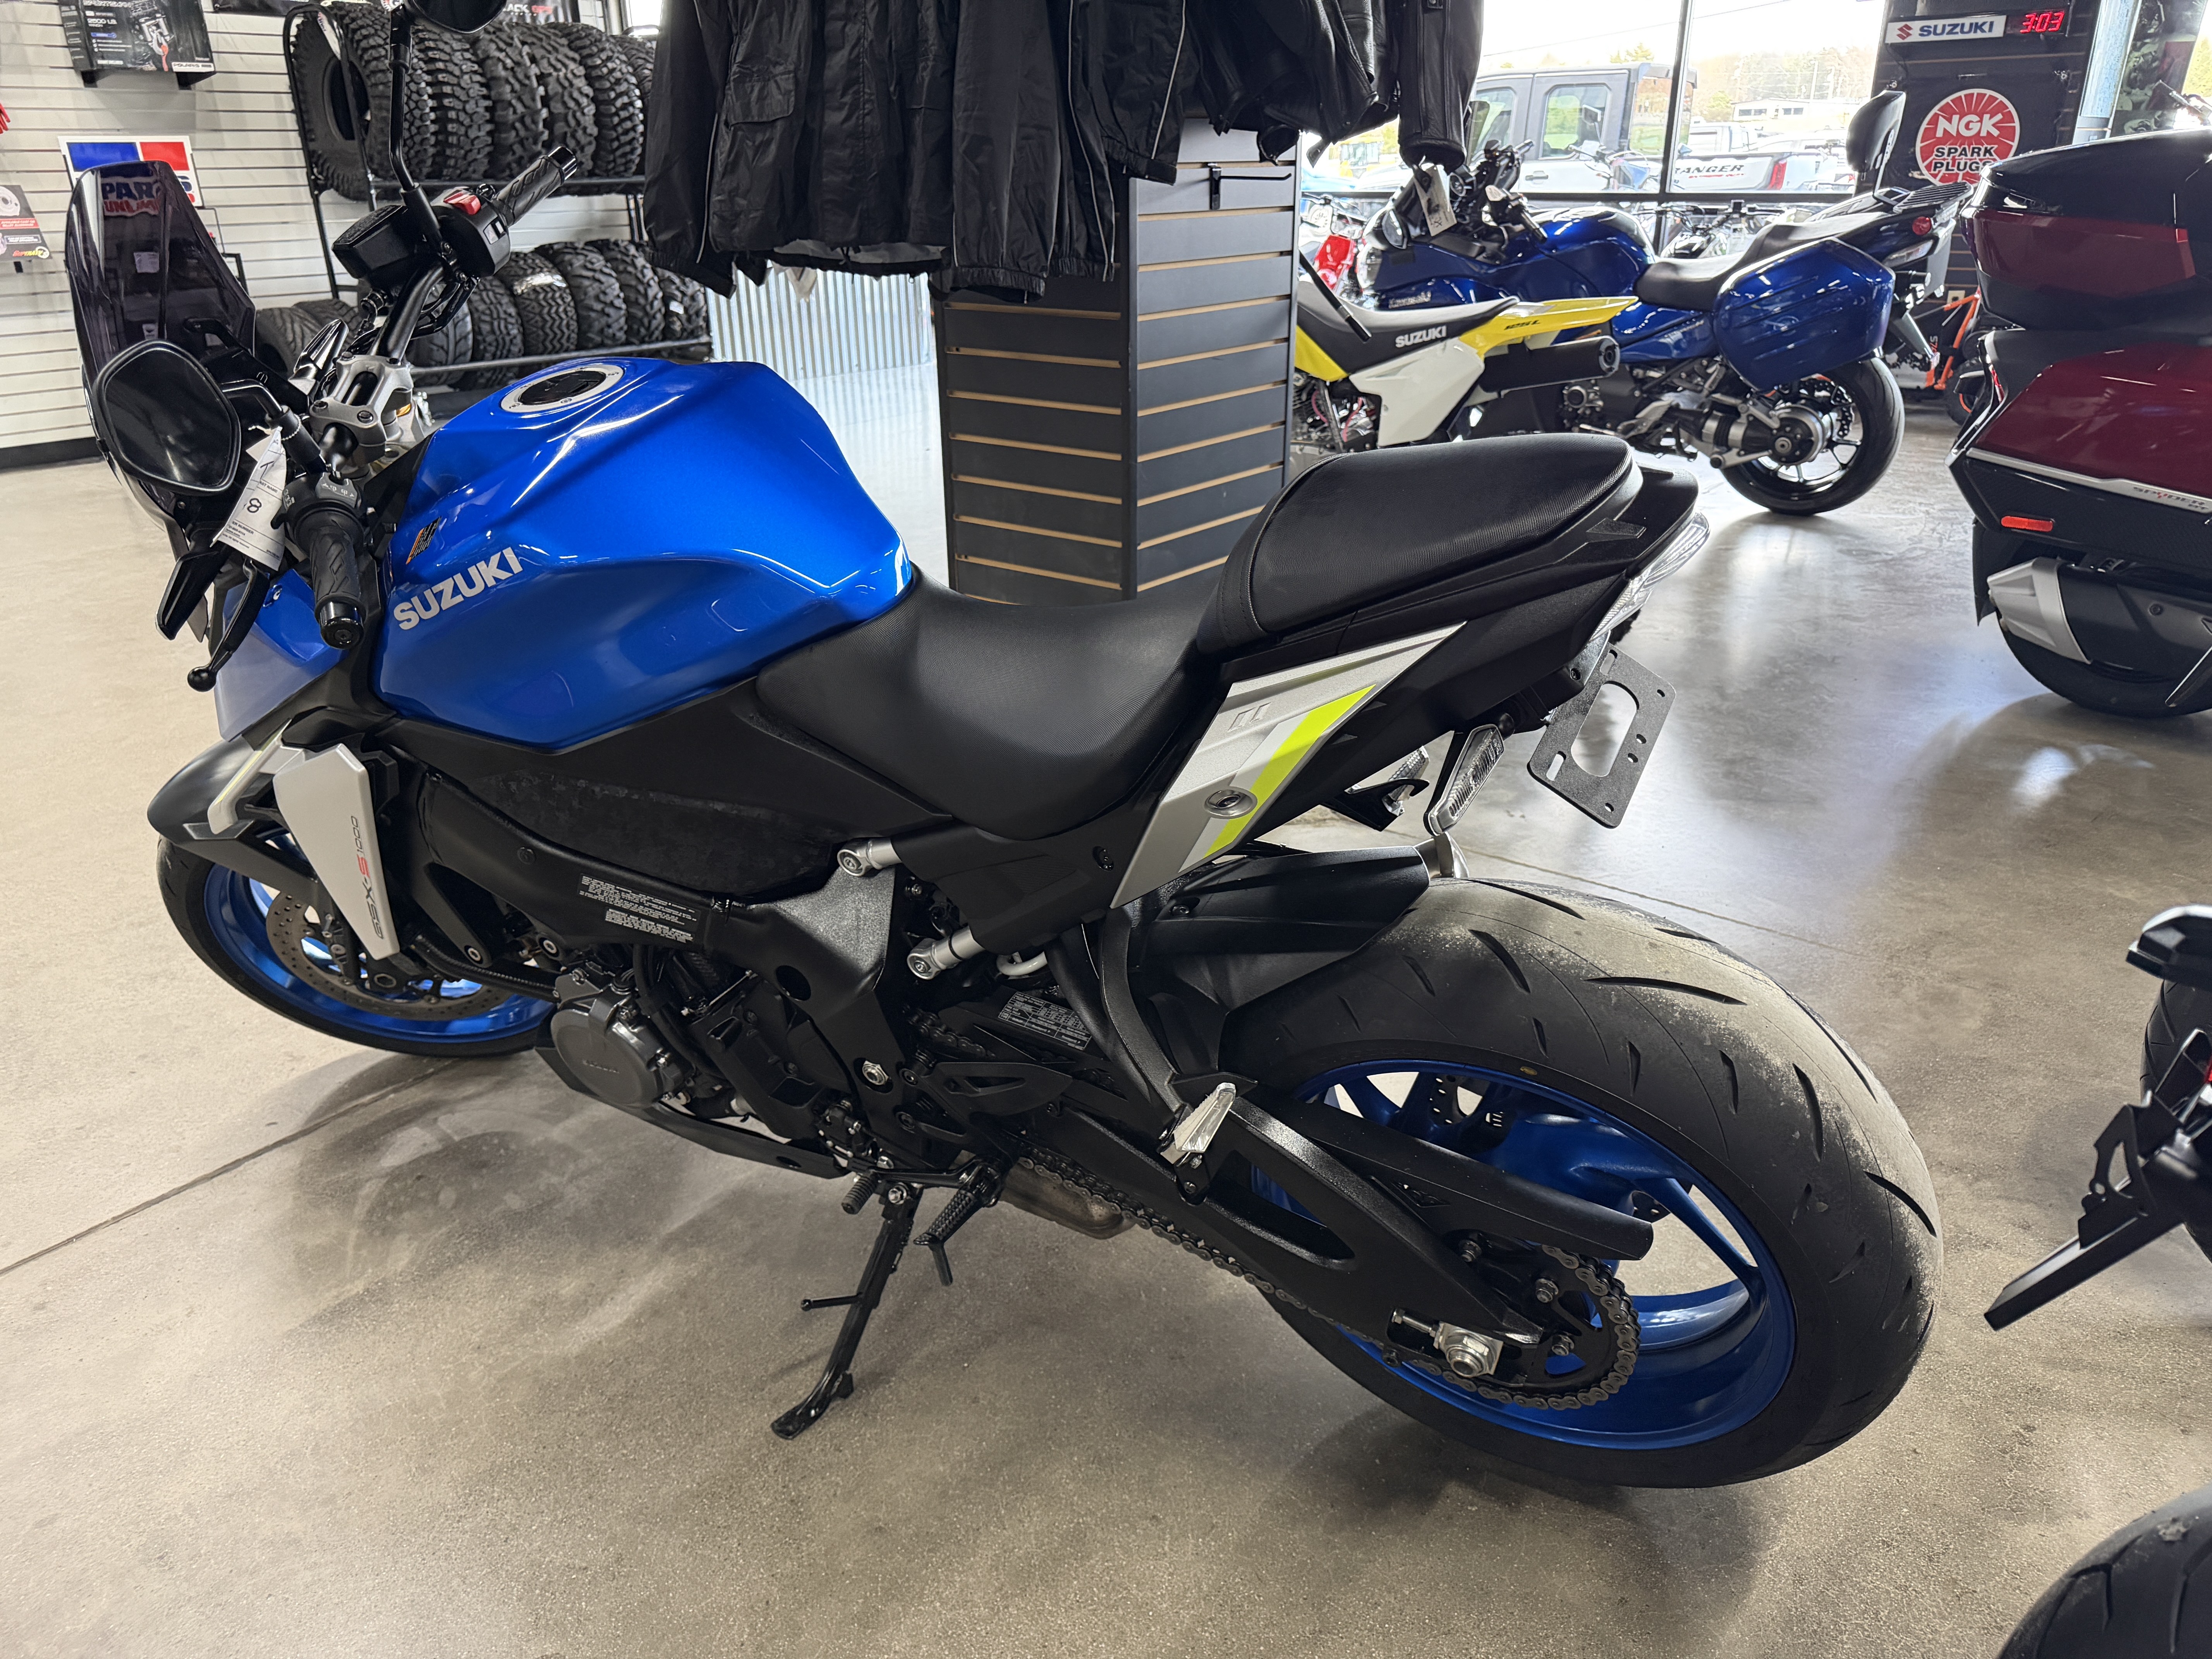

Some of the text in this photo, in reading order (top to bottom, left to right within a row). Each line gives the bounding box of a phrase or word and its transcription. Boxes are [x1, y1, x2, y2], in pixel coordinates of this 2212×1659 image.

[1918, 21, 1994, 37] SUZUKI
[2020, 12, 2065, 33] 3:03
[1936, 113, 2003, 137] NGK
[1934, 145, 1997, 158] SPARK
[1395, 325, 1447, 348] SUZUKI
[393, 546, 523, 630] SUZUKI
[350, 815, 384, 939] GSX-S1000
